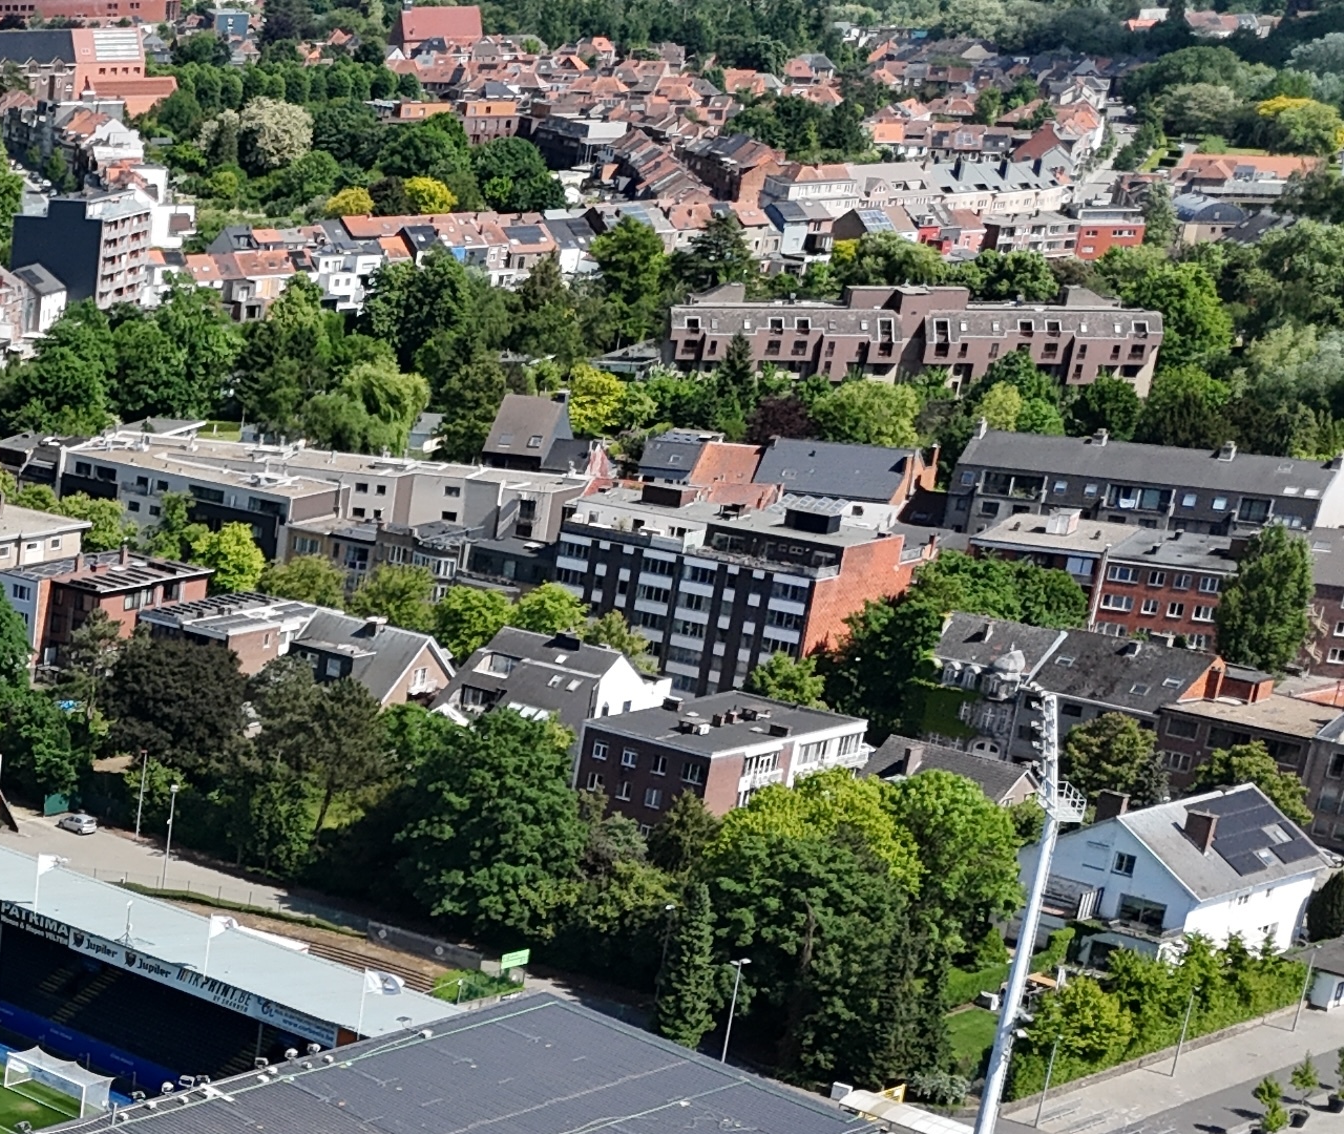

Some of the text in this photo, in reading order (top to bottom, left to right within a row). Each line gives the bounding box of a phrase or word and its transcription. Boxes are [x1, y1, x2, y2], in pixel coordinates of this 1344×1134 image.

[1, 902, 69, 937] PATRIMA
[85, 938, 119, 959] Jupiler
[137, 958, 172, 979] Jupiler
